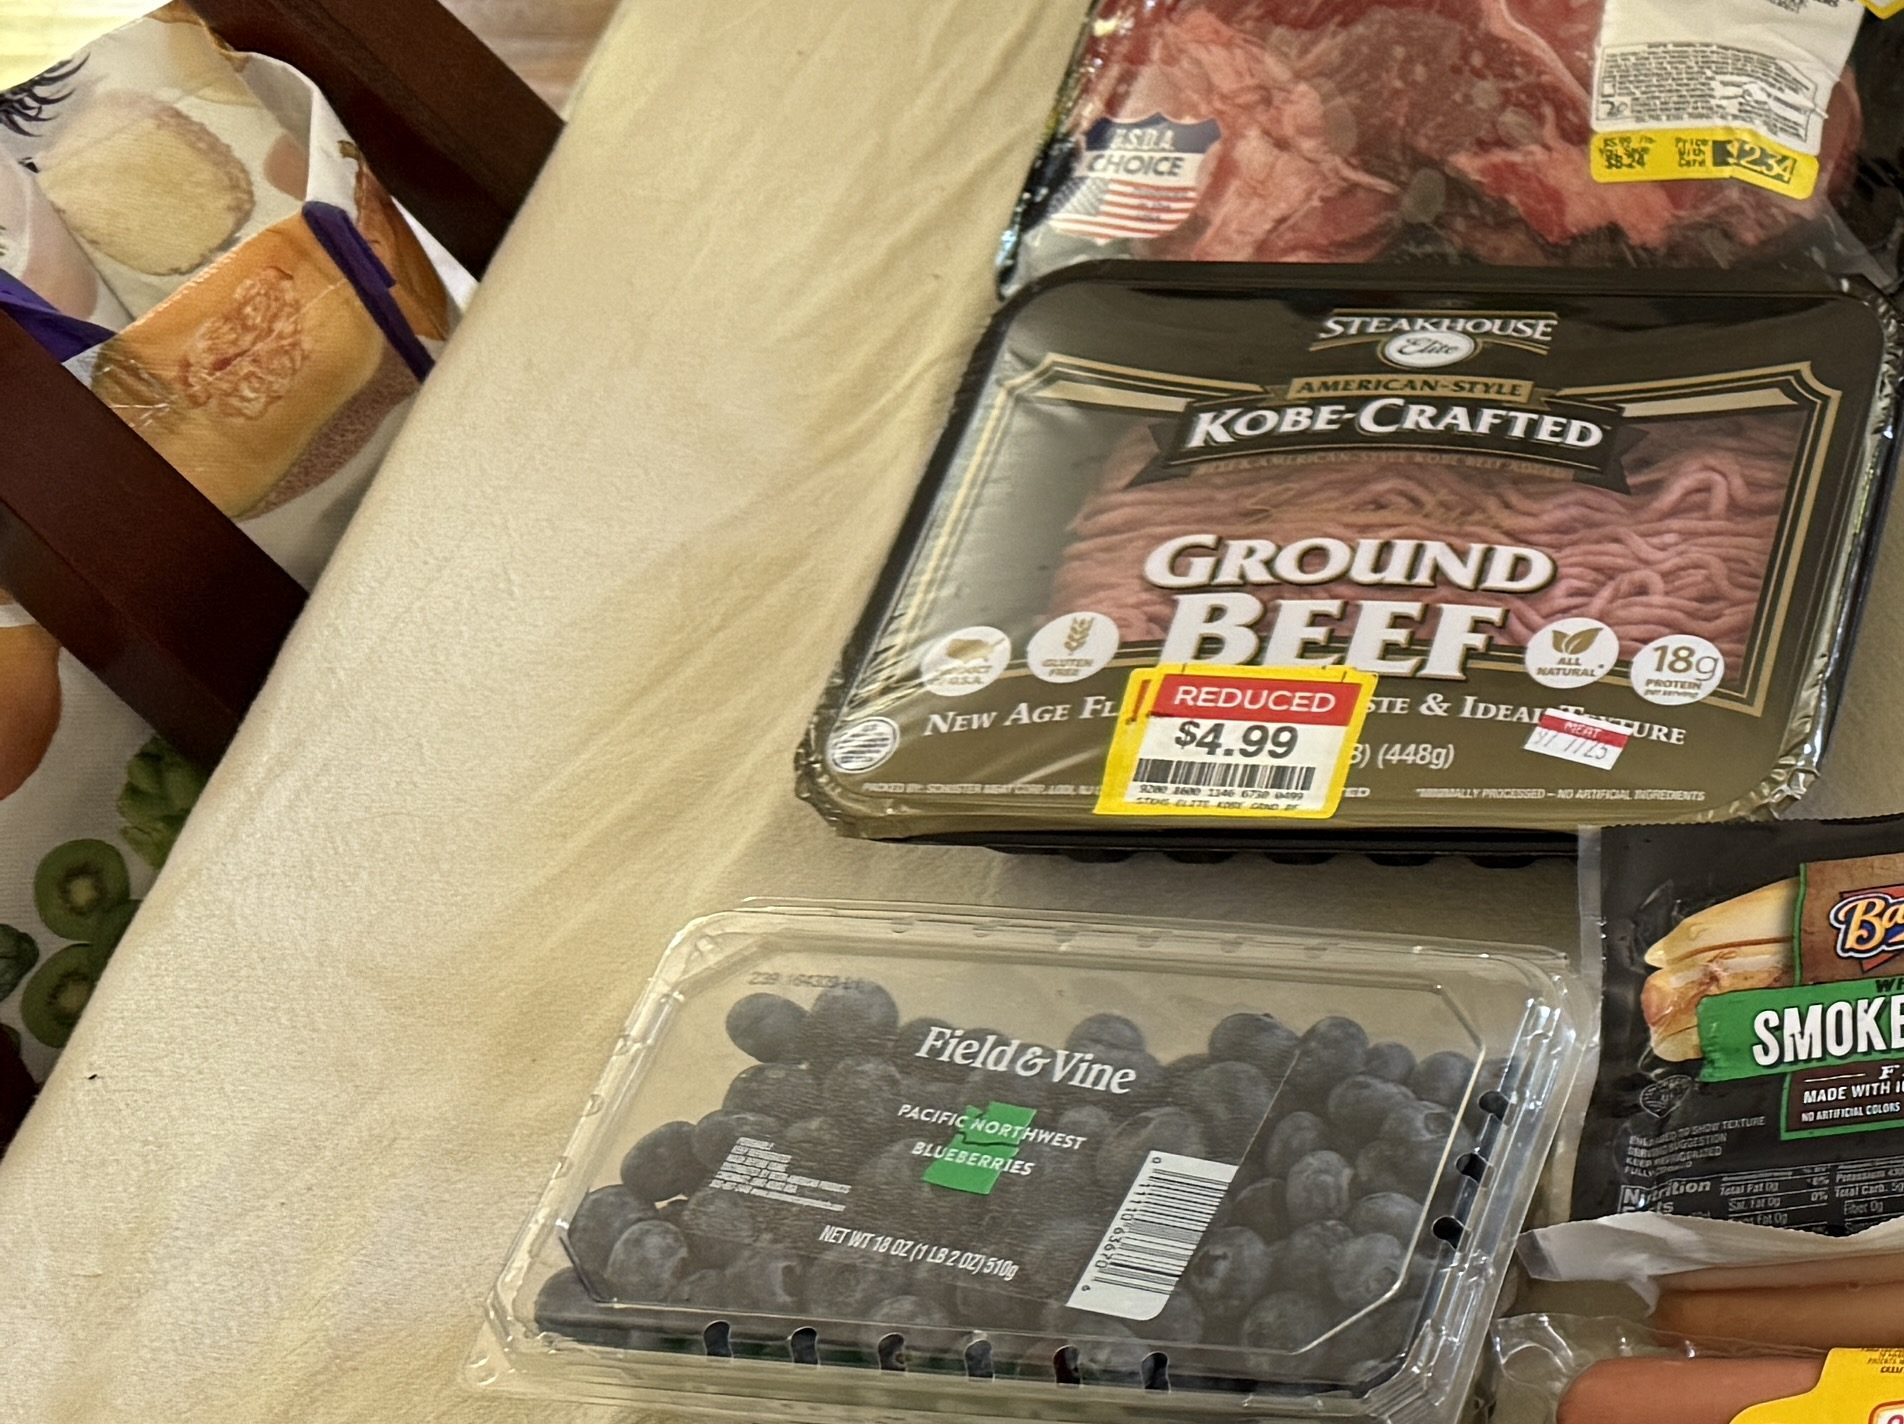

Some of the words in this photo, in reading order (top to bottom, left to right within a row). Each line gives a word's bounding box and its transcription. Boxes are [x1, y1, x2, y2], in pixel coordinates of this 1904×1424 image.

[1086, 152, 1185, 177] CHOICE
[1319, 312, 1559, 345] STEAKHOUSE
[1294, 377, 1526, 400] AMERICAN-STYLE
[1186, 399, 1606, 452] KOBE-CRAFTED
[1142, 533, 1557, 592] GROUND
[1158, 592, 1506, 682] BEEF
[1647, 642, 1719, 681] 18g
[1172, 684, 1337, 713] REDUCED
[1173, 716, 1300, 759] $4.99
[898, 1103, 969, 1129] PACIFIC
[970, 1117, 1088, 1151] NORTHWEST
[911, 1141, 1036, 1176] BLUEBERRIES
